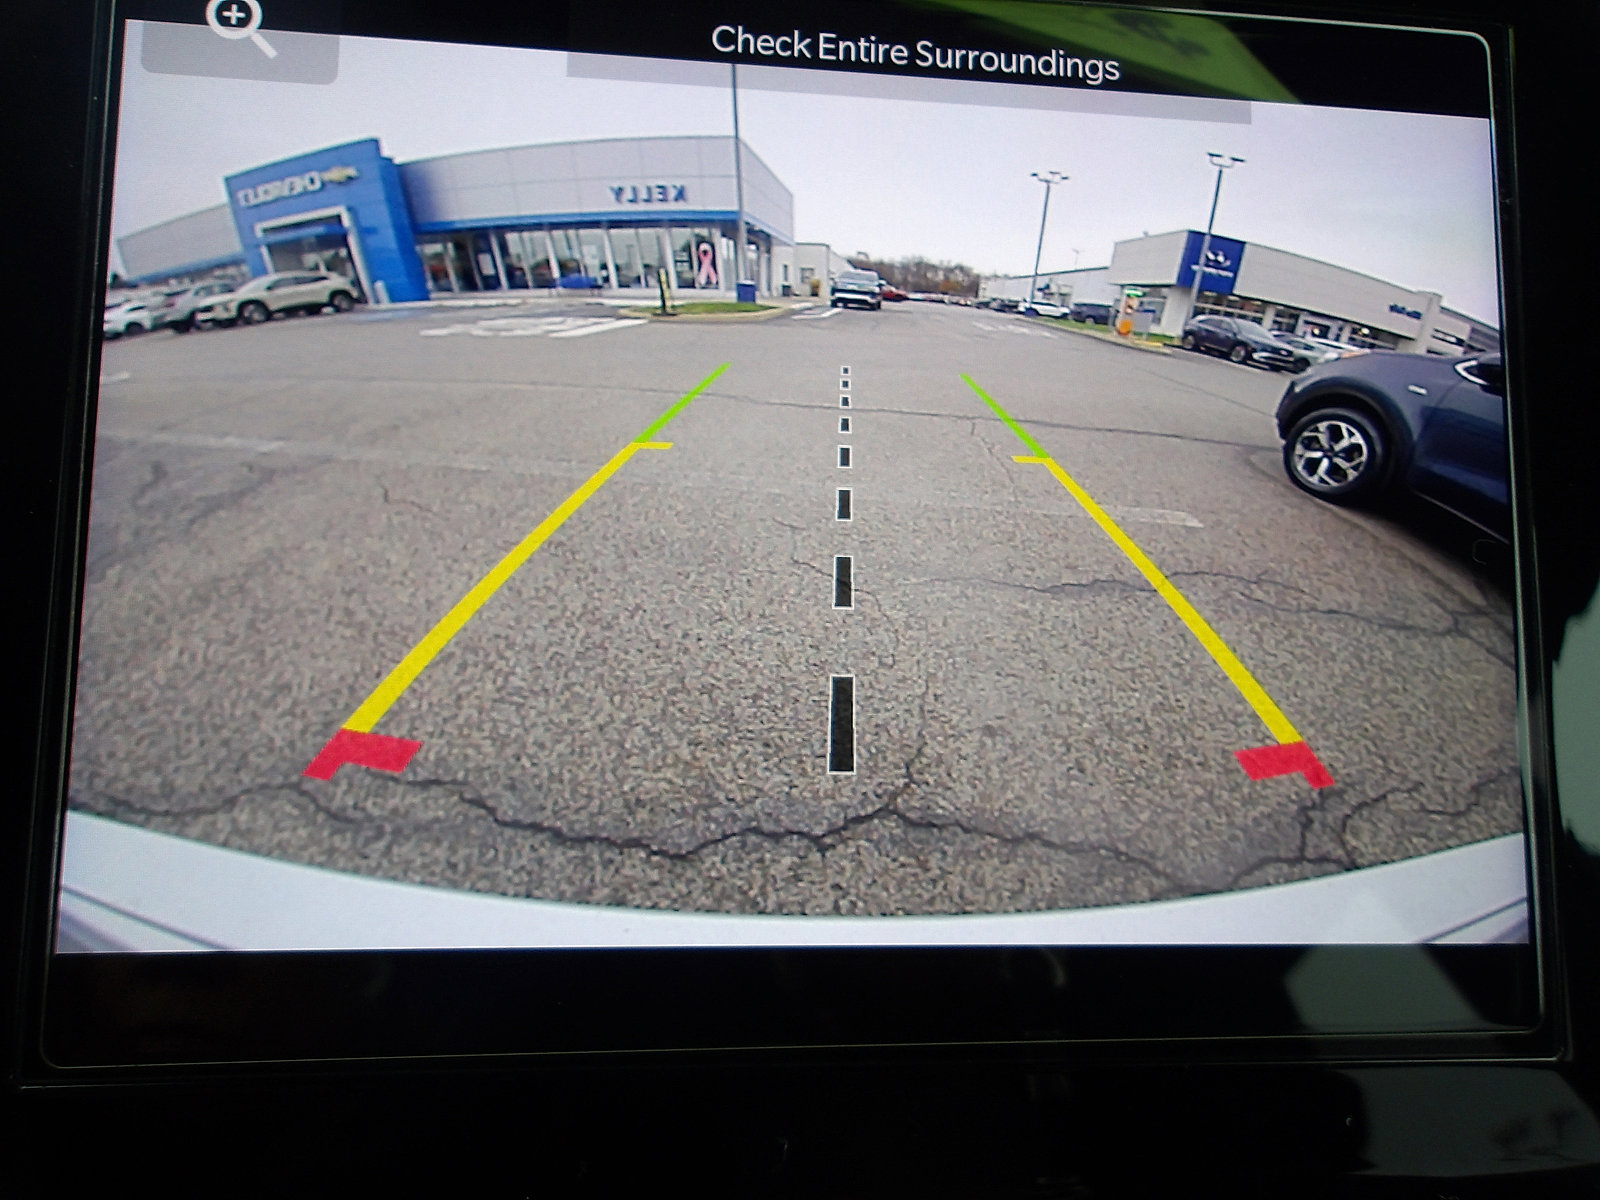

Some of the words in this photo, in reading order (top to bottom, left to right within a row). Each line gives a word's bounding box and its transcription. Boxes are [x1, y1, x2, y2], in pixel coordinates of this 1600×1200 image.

[711, 24, 812, 59] Check
[817, 32, 908, 66] Entire
[915, 40, 1121, 85] Surroundings
